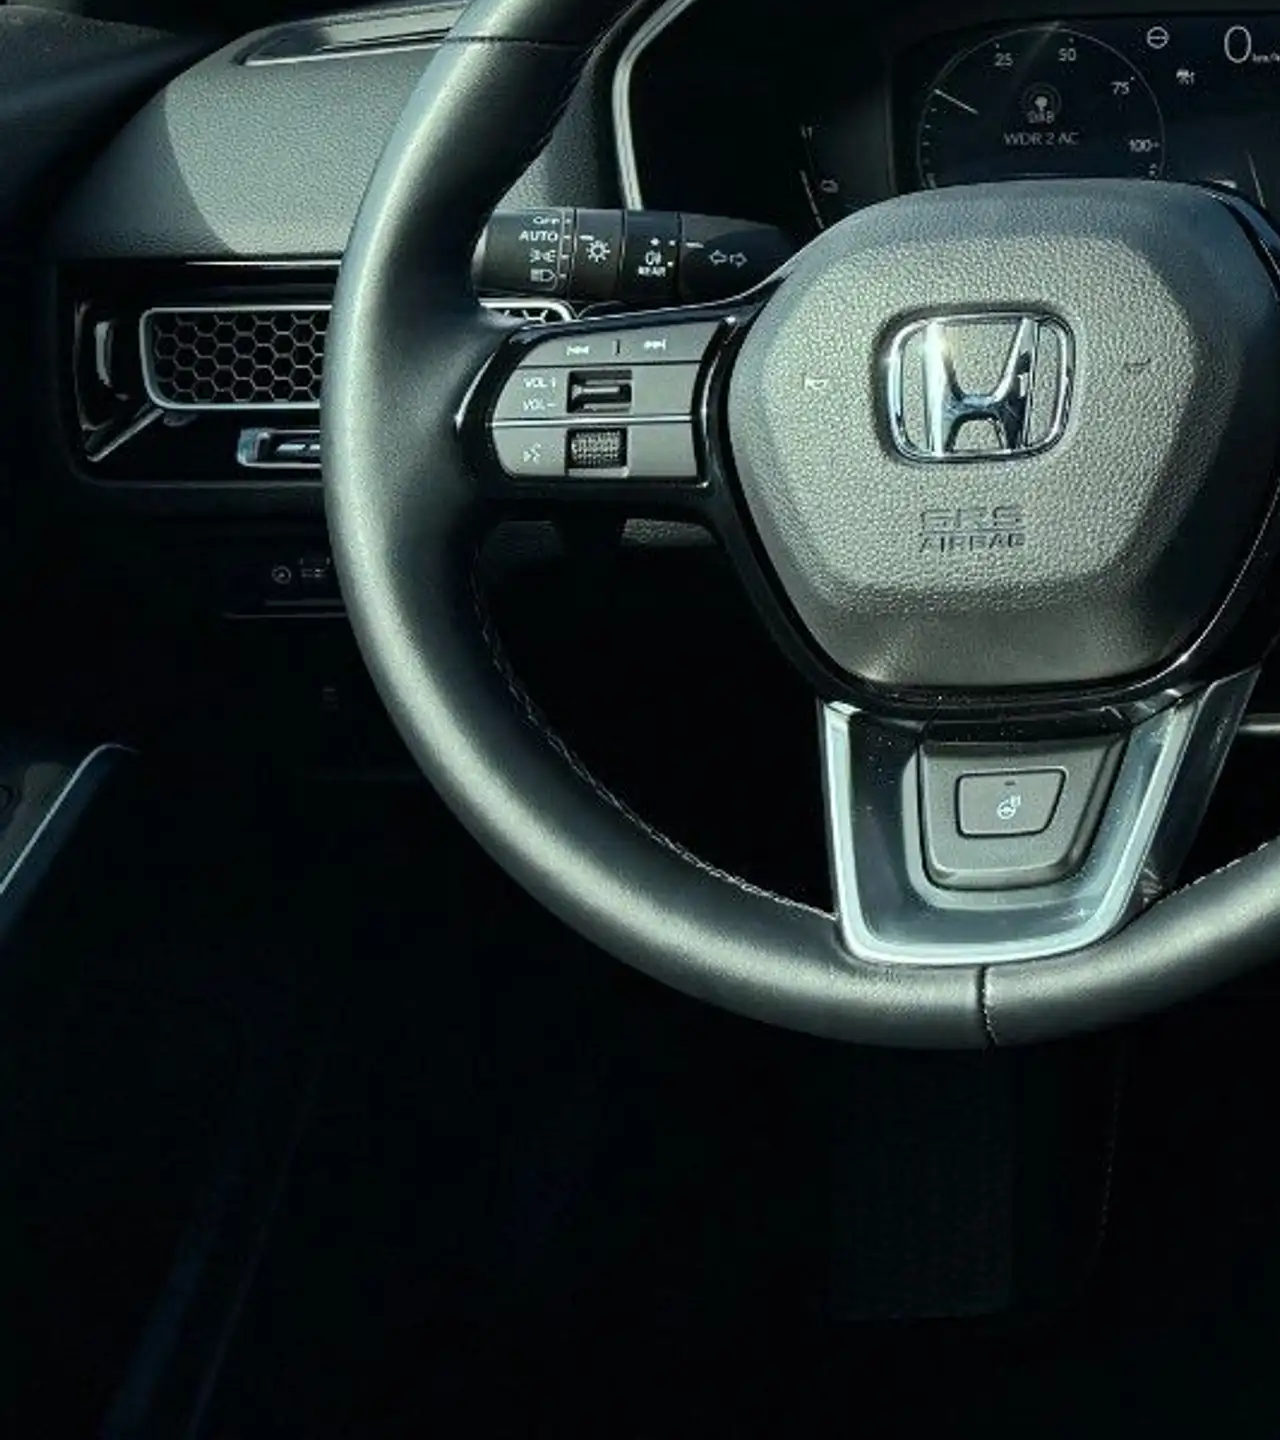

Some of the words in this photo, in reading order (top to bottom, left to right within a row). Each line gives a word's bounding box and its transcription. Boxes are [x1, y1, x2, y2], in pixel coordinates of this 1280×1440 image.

[1223, 25, 1253, 64] 0
[994, 52, 1014, 67] 25
[1058, 47, 1077, 62] 50
[1111, 81, 1130, 96] 75
[1004, 131, 1042, 147] WDR
[1045, 131, 1055, 146] 2
[1058, 131, 1080, 146] AC
[1128, 138, 1152, 154] 100
[518, 229, 559, 243] AUTO
[920, 506, 1027, 533] SRS
[919, 535, 1027, 554] AIRBAG
